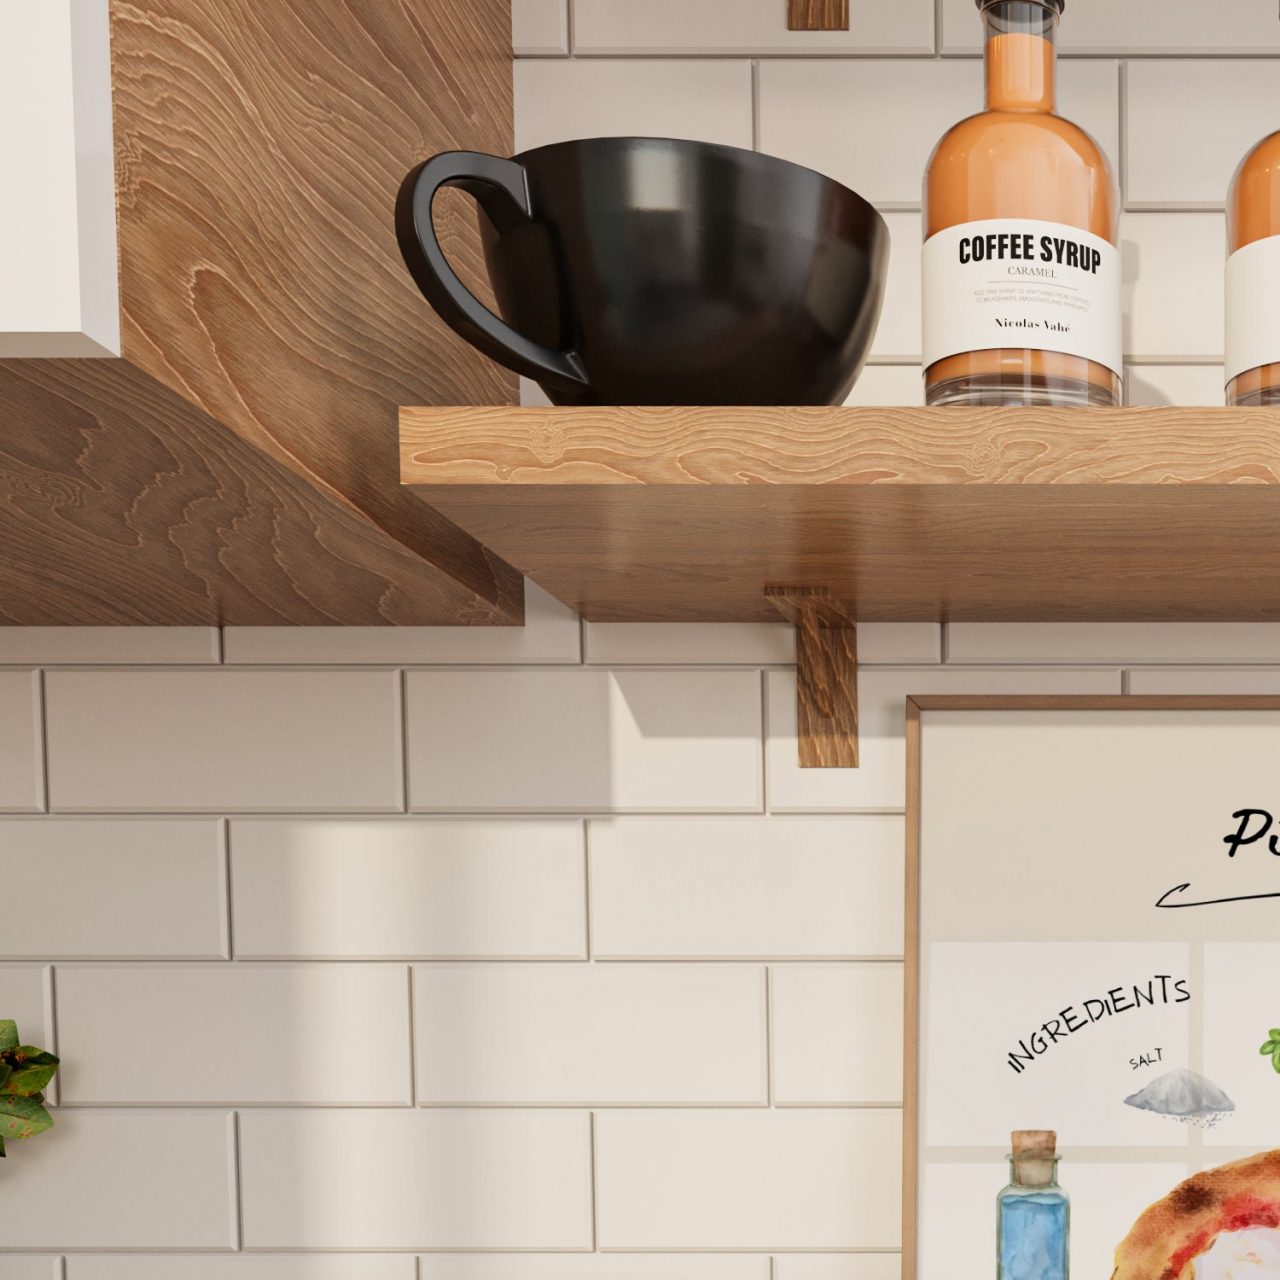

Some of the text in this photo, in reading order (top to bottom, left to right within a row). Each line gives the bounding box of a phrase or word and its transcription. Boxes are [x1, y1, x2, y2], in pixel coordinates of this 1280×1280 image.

[959, 234, 1101, 274] COFFEE SYRUP
[1007, 266, 1057, 279] CARAMEL
[1008, 975, 1190, 1073] INGREDIENTS
[1130, 1048, 1161, 1069] SALT
